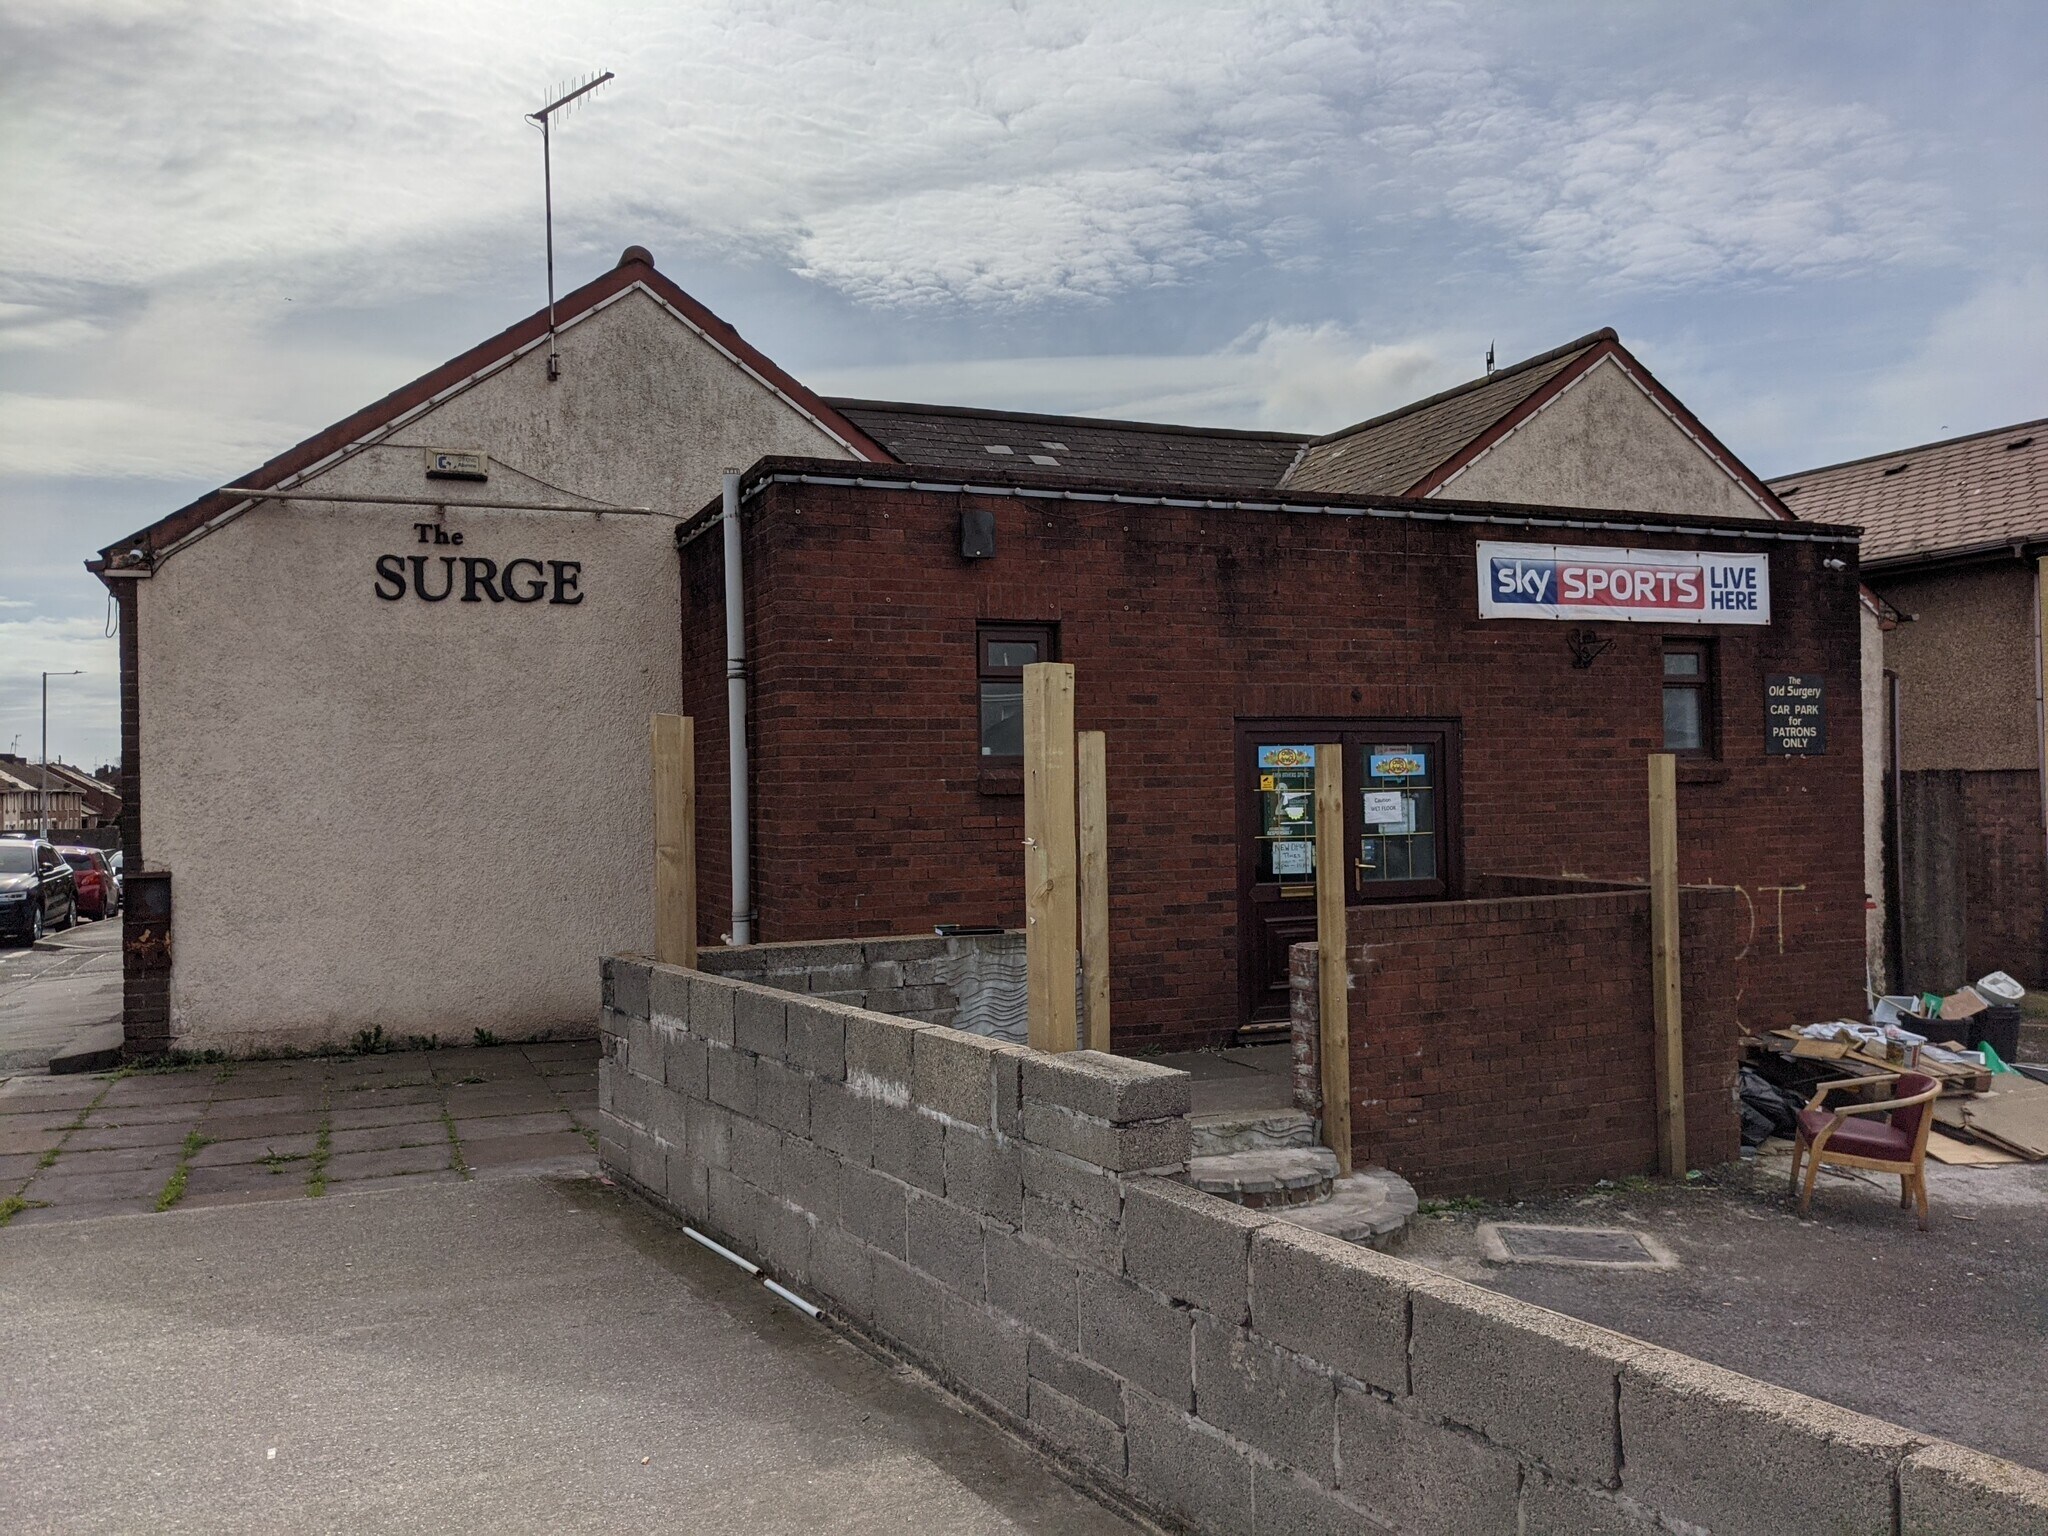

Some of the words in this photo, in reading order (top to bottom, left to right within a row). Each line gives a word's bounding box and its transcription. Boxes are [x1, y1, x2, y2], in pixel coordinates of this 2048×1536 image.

[413, 522, 464, 545] The
[374, 554, 584, 605] SURGE
[1497, 560, 1551, 602] sky
[1562, 567, 1698, 603] SPORTS
[1710, 566, 1757, 590] LIVE
[1710, 591, 1758, 611] HERE
[1788, 676, 1802, 685] The
[1768, 685, 1785, 696] Old
[1786, 685, 1822, 699] Surgery
[1770, 704, 1790, 715] CAR
[1794, 704, 1819, 715] PARK
[1788, 715, 1802, 726] for
[1772, 726, 1817, 737] PATRONS
[1782, 738, 1808, 748] ONLY
